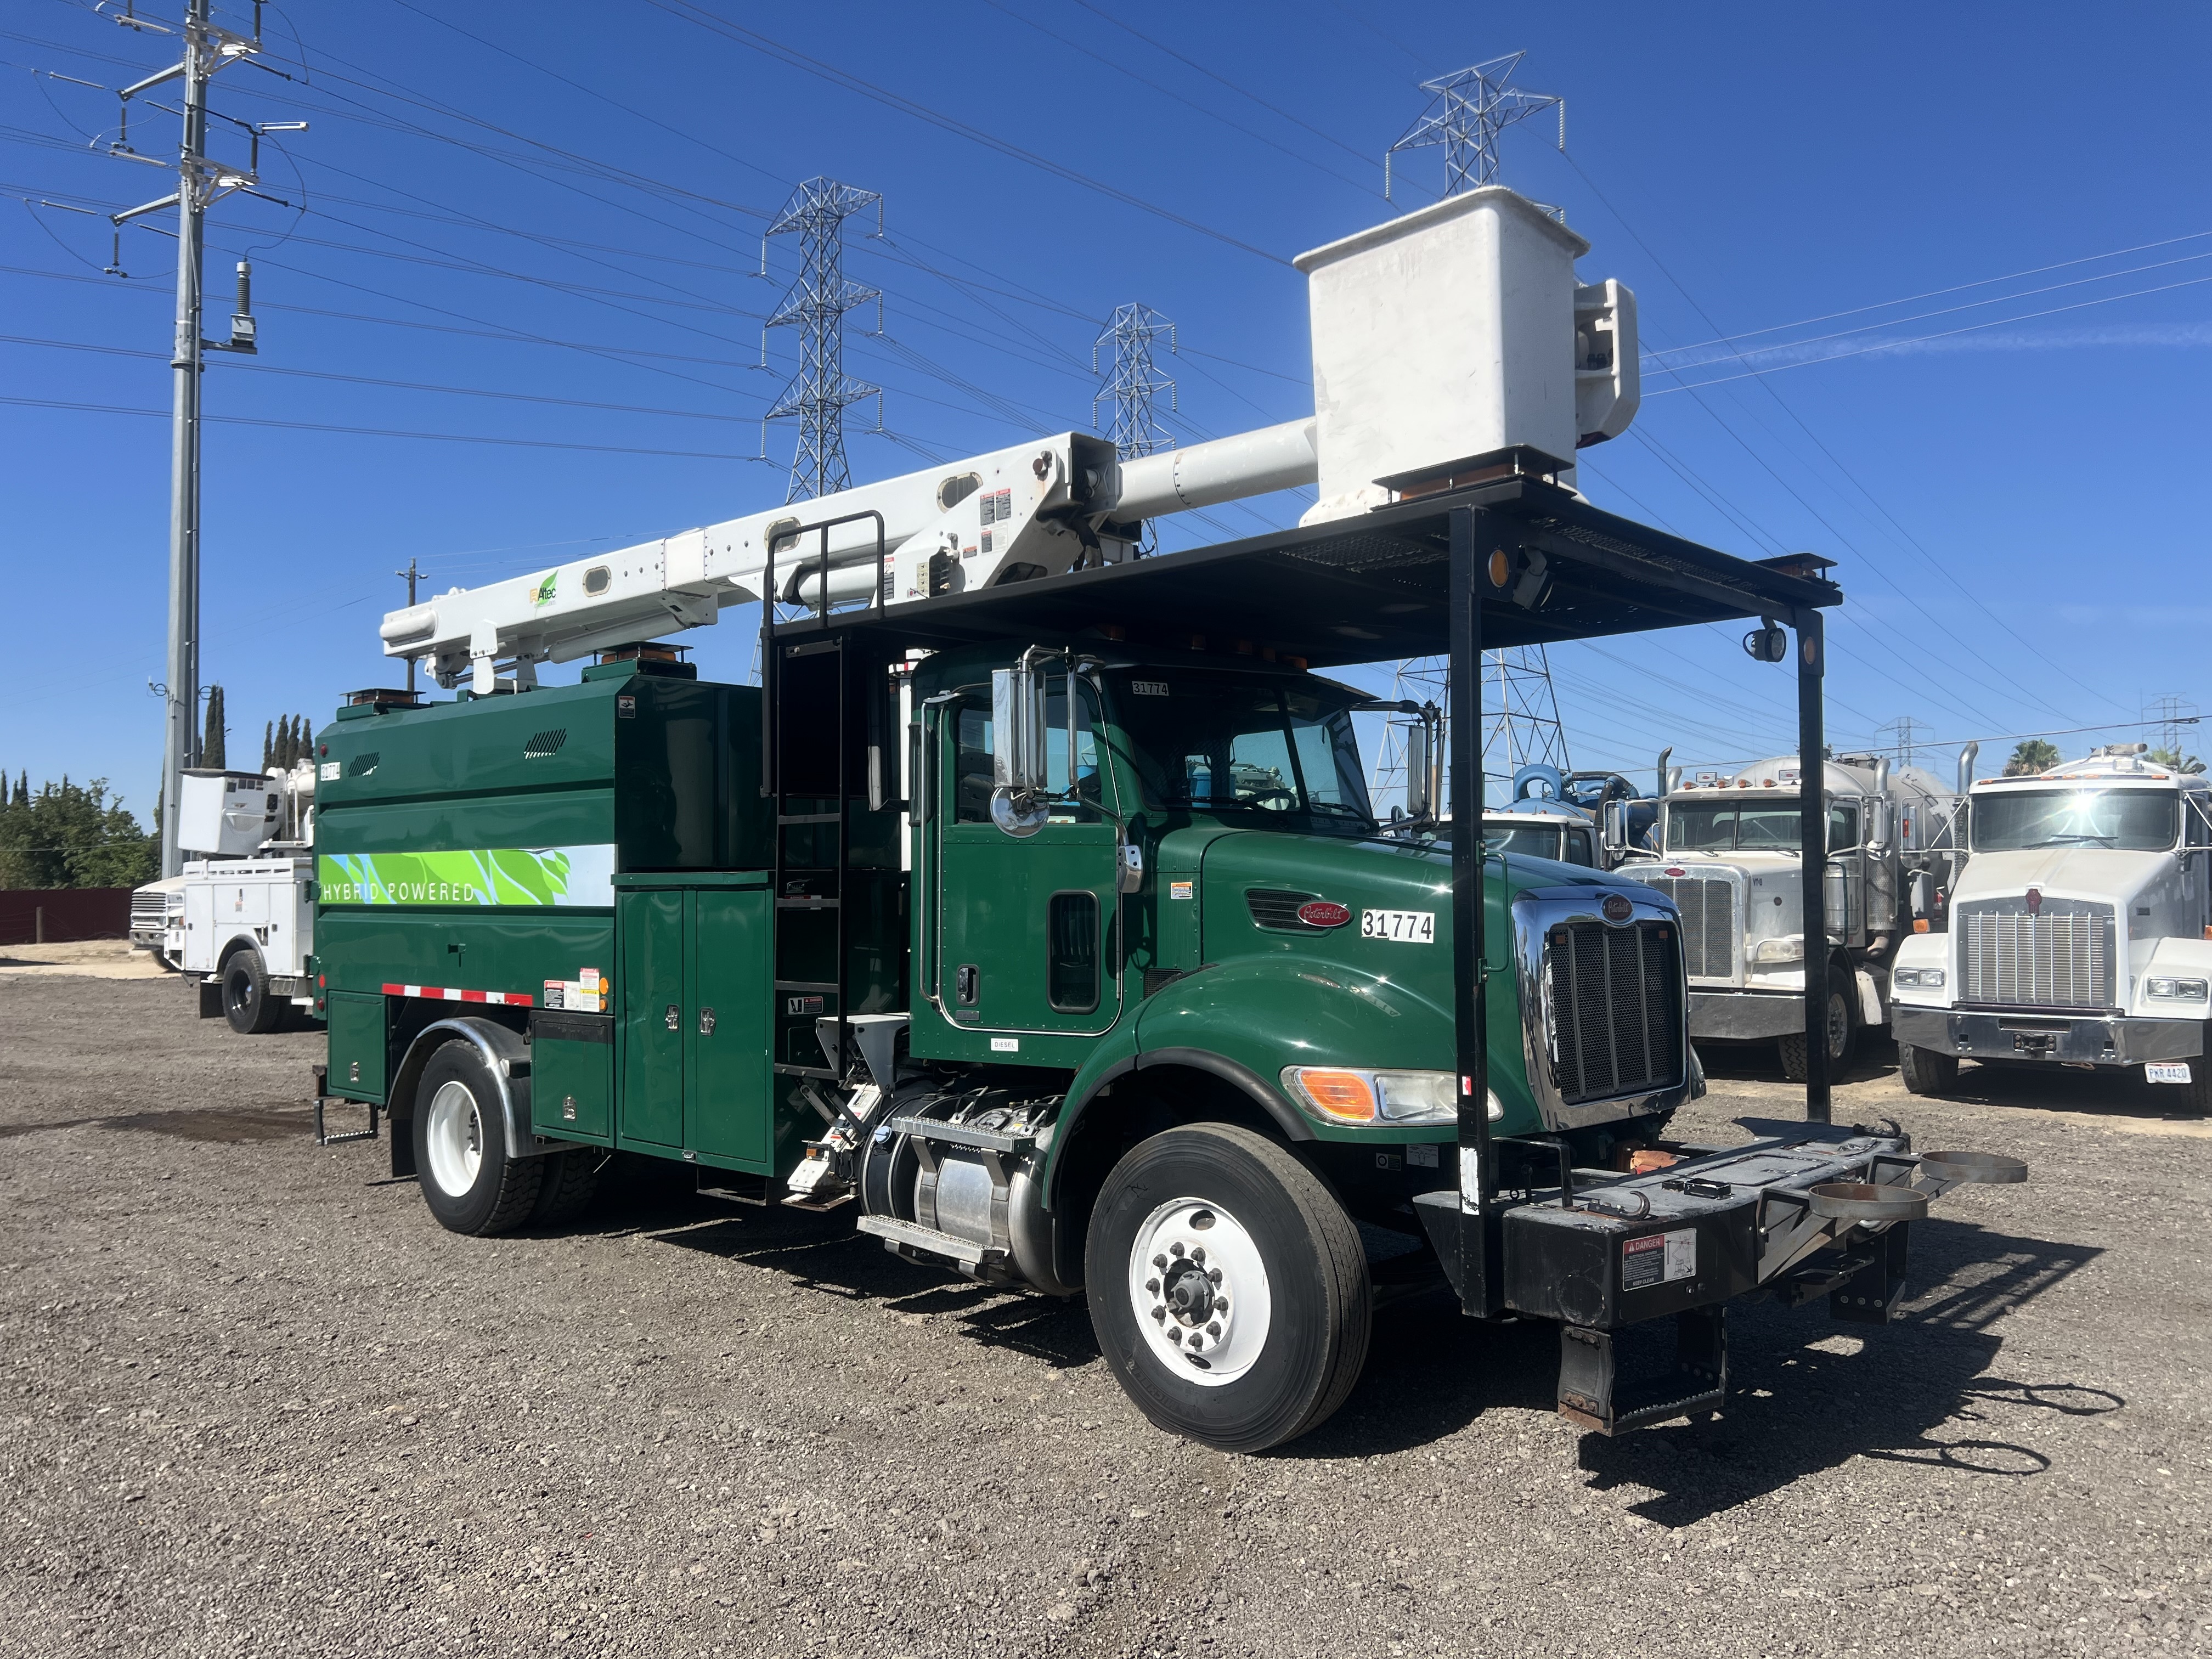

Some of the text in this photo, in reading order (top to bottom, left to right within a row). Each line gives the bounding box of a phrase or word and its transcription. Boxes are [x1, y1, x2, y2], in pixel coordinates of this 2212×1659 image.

[1133, 682, 1168, 695] 31774
[323, 882, 474, 901] HYBRID POWERED
[1304, 905, 1346, 919] Peterbilt
[1362, 911, 1432, 940] 31774
[2167, 1068, 2187, 1078] 4420
[1635, 1238, 1660, 1250] DANGER
